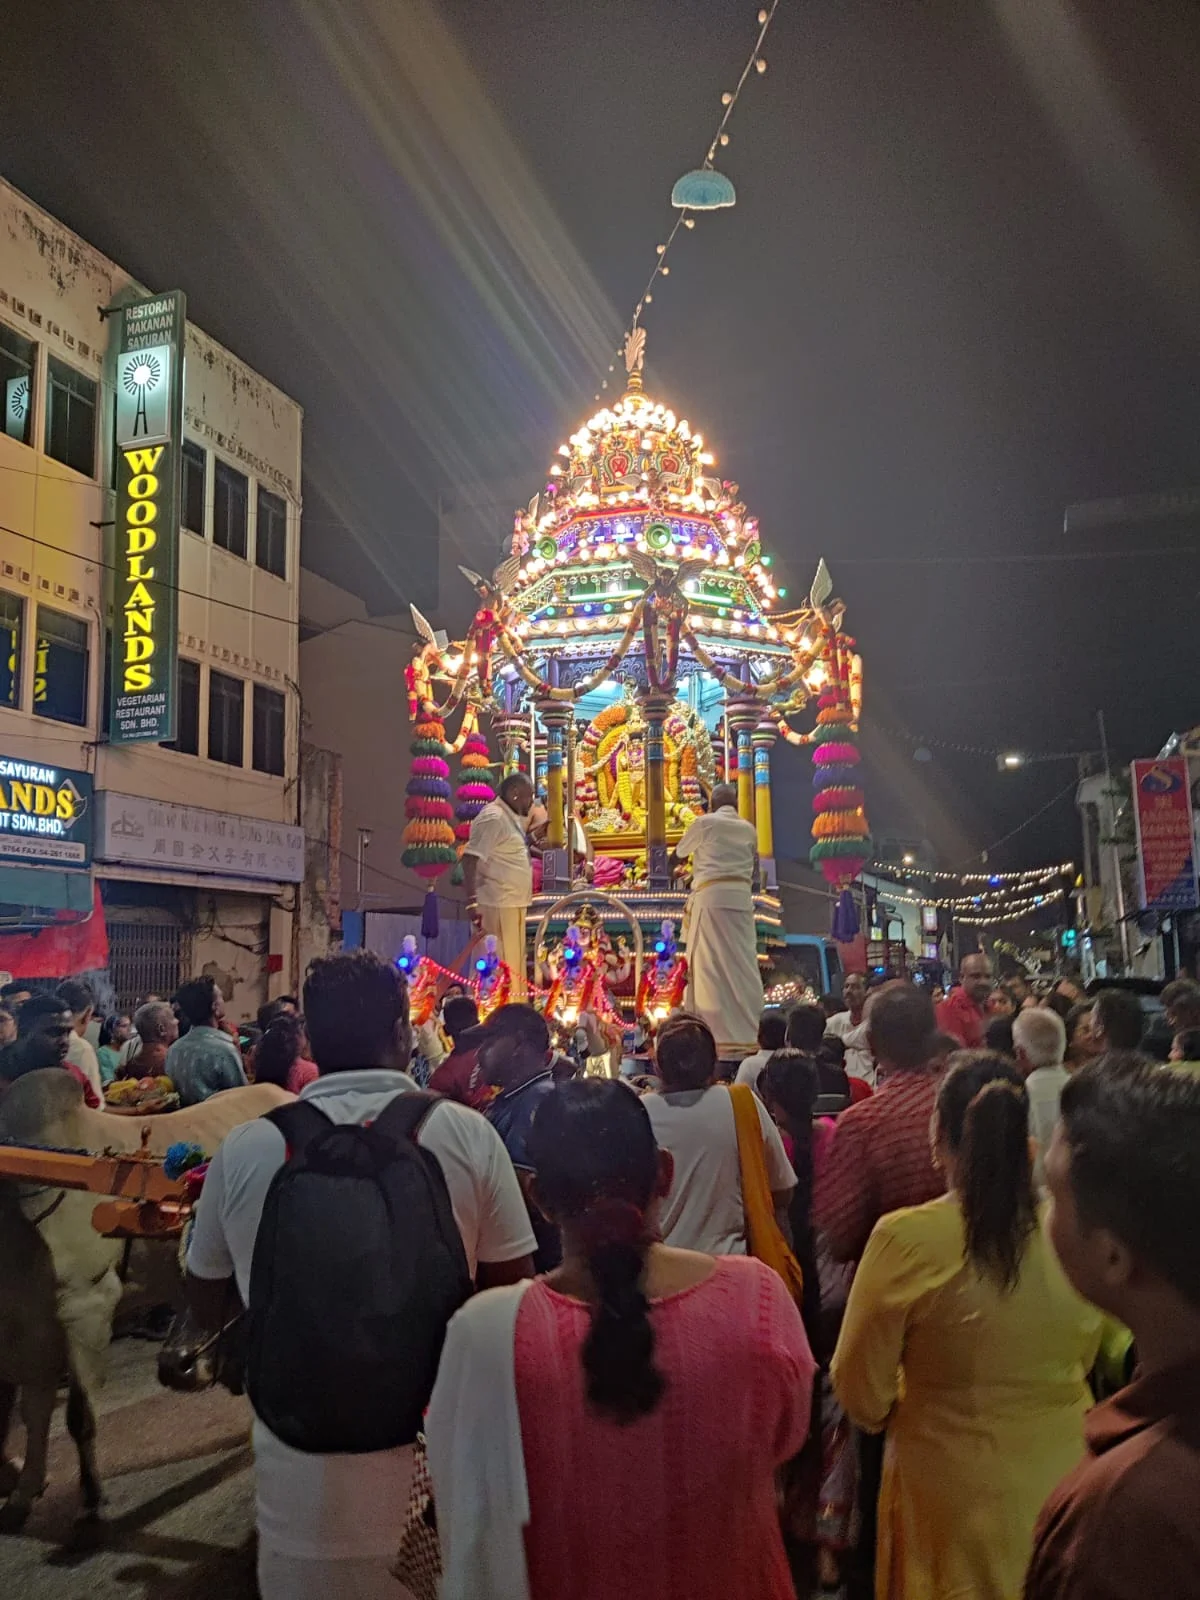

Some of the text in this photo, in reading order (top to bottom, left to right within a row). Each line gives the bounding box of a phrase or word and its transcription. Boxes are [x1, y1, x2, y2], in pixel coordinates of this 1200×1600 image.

[126, 298, 175, 321] RESTORAN
[126, 315, 174, 336] MAKANAN
[127, 330, 172, 350] SAYURAN
[124, 446, 165, 693] WOODLANDS
[117, 693, 165, 707] VEGETARIAN
[115, 704, 166, 719] RESTAURANT
[120, 717, 159, 730] SDN. BHD.
[0, 761, 54, 784] SAYURAN
